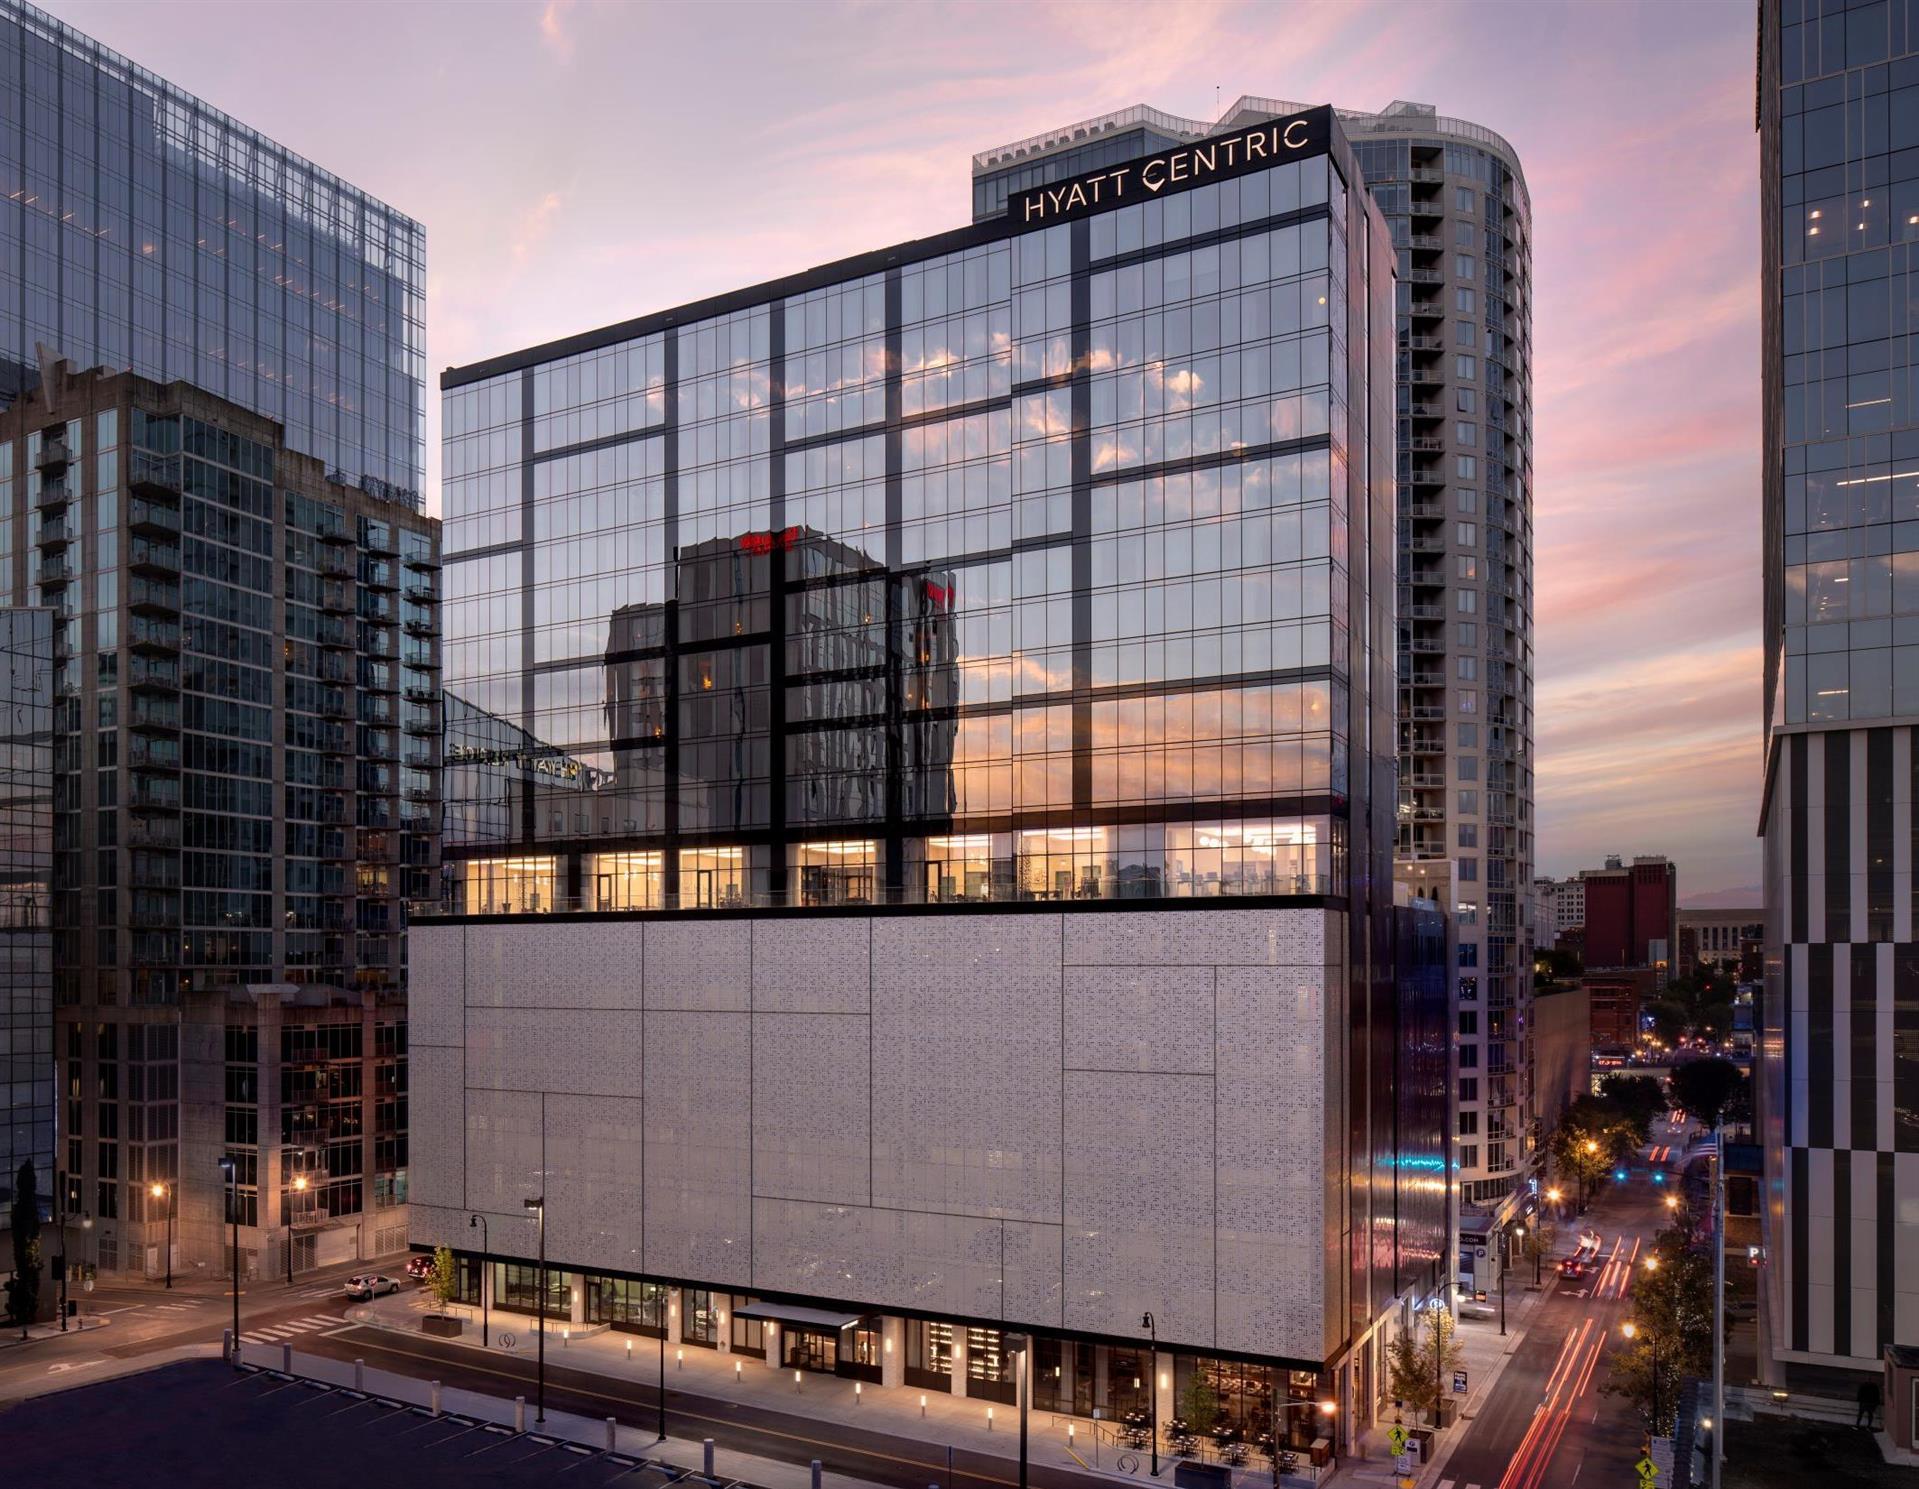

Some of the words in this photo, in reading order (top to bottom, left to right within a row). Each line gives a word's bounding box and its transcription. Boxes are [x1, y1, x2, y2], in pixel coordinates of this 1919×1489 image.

[1025, 168, 1129, 222] HYATT
[1142, 120, 1309, 192] CENTRIC
[1749, 1247, 1759, 1258] P
